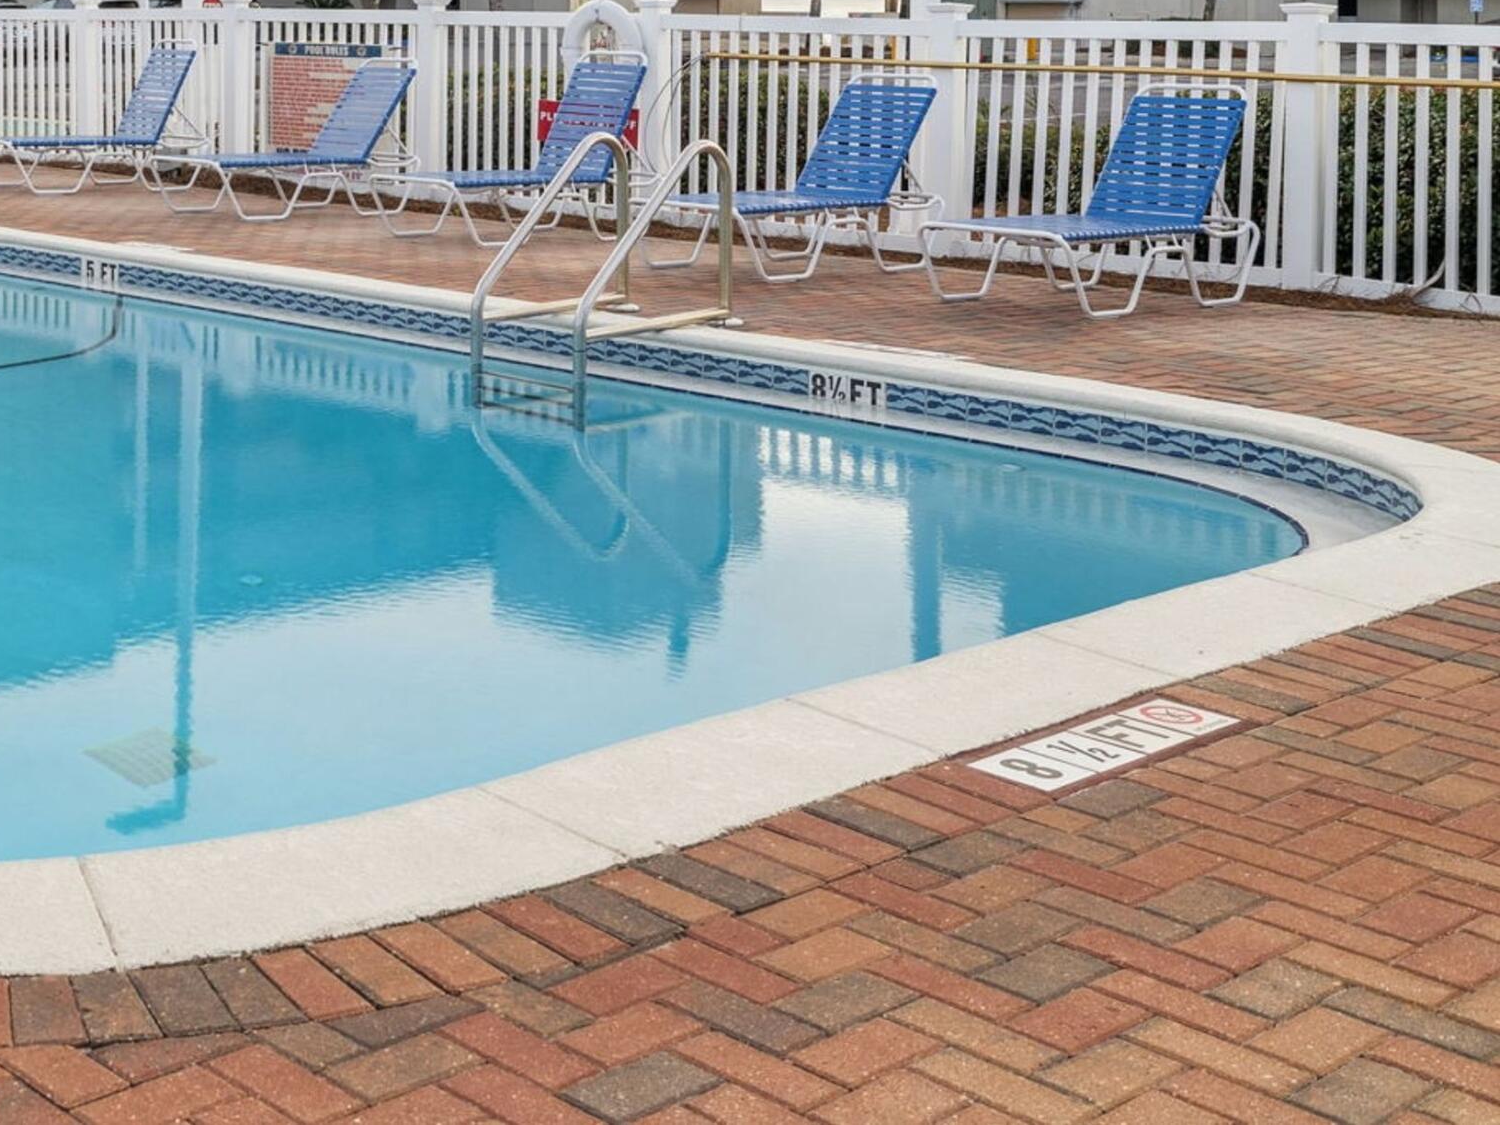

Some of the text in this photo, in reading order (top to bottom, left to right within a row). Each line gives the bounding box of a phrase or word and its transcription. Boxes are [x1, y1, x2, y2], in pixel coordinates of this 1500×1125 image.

[304, 44, 350, 56] POOL RULES
[86, 260, 117, 283] 5 FT
[850, 378, 881, 406] FT
[1086, 719, 1168, 749] FT
